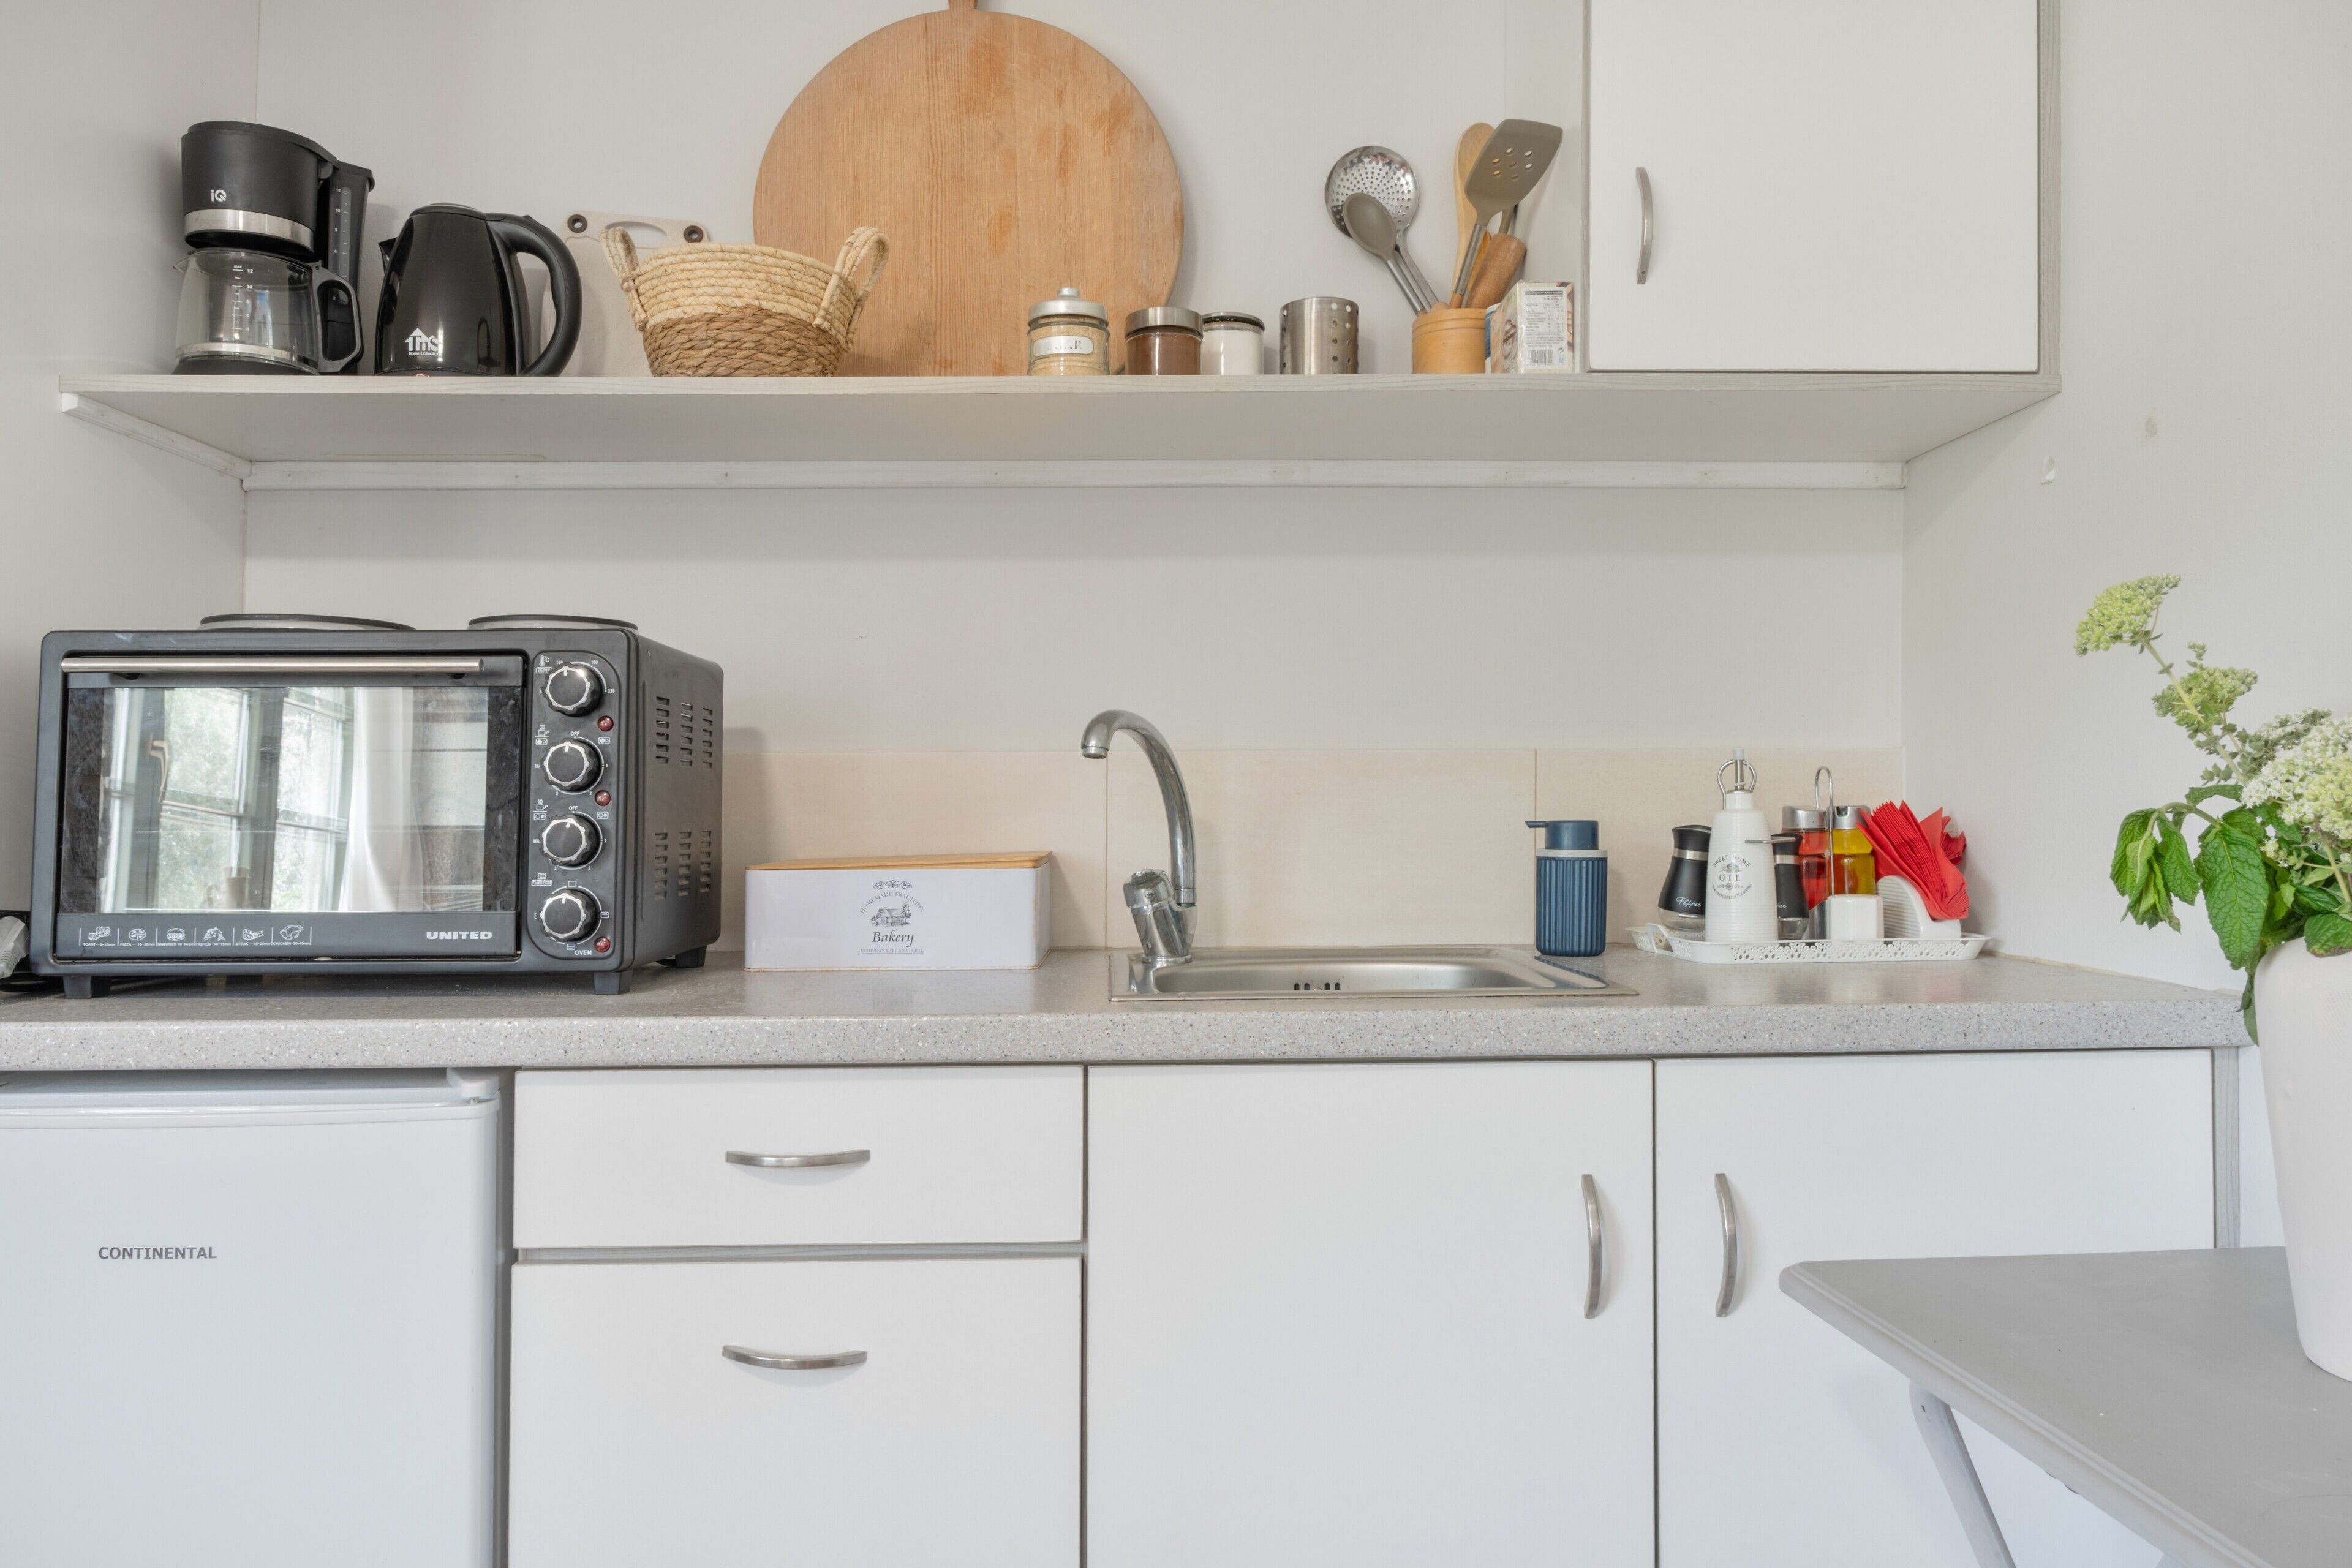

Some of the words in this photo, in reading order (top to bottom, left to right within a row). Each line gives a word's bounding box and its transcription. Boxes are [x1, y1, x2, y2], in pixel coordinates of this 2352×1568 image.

[1713, 854, 1729, 868] SWEET
[859, 891, 894, 914] HOMEMADE
[894, 891, 924, 912] TRADITION
[426, 931, 492, 940] UNITED
[872, 929, 914, 948] Bakery
[99, 1247, 217, 1259] CONTINENTAL
